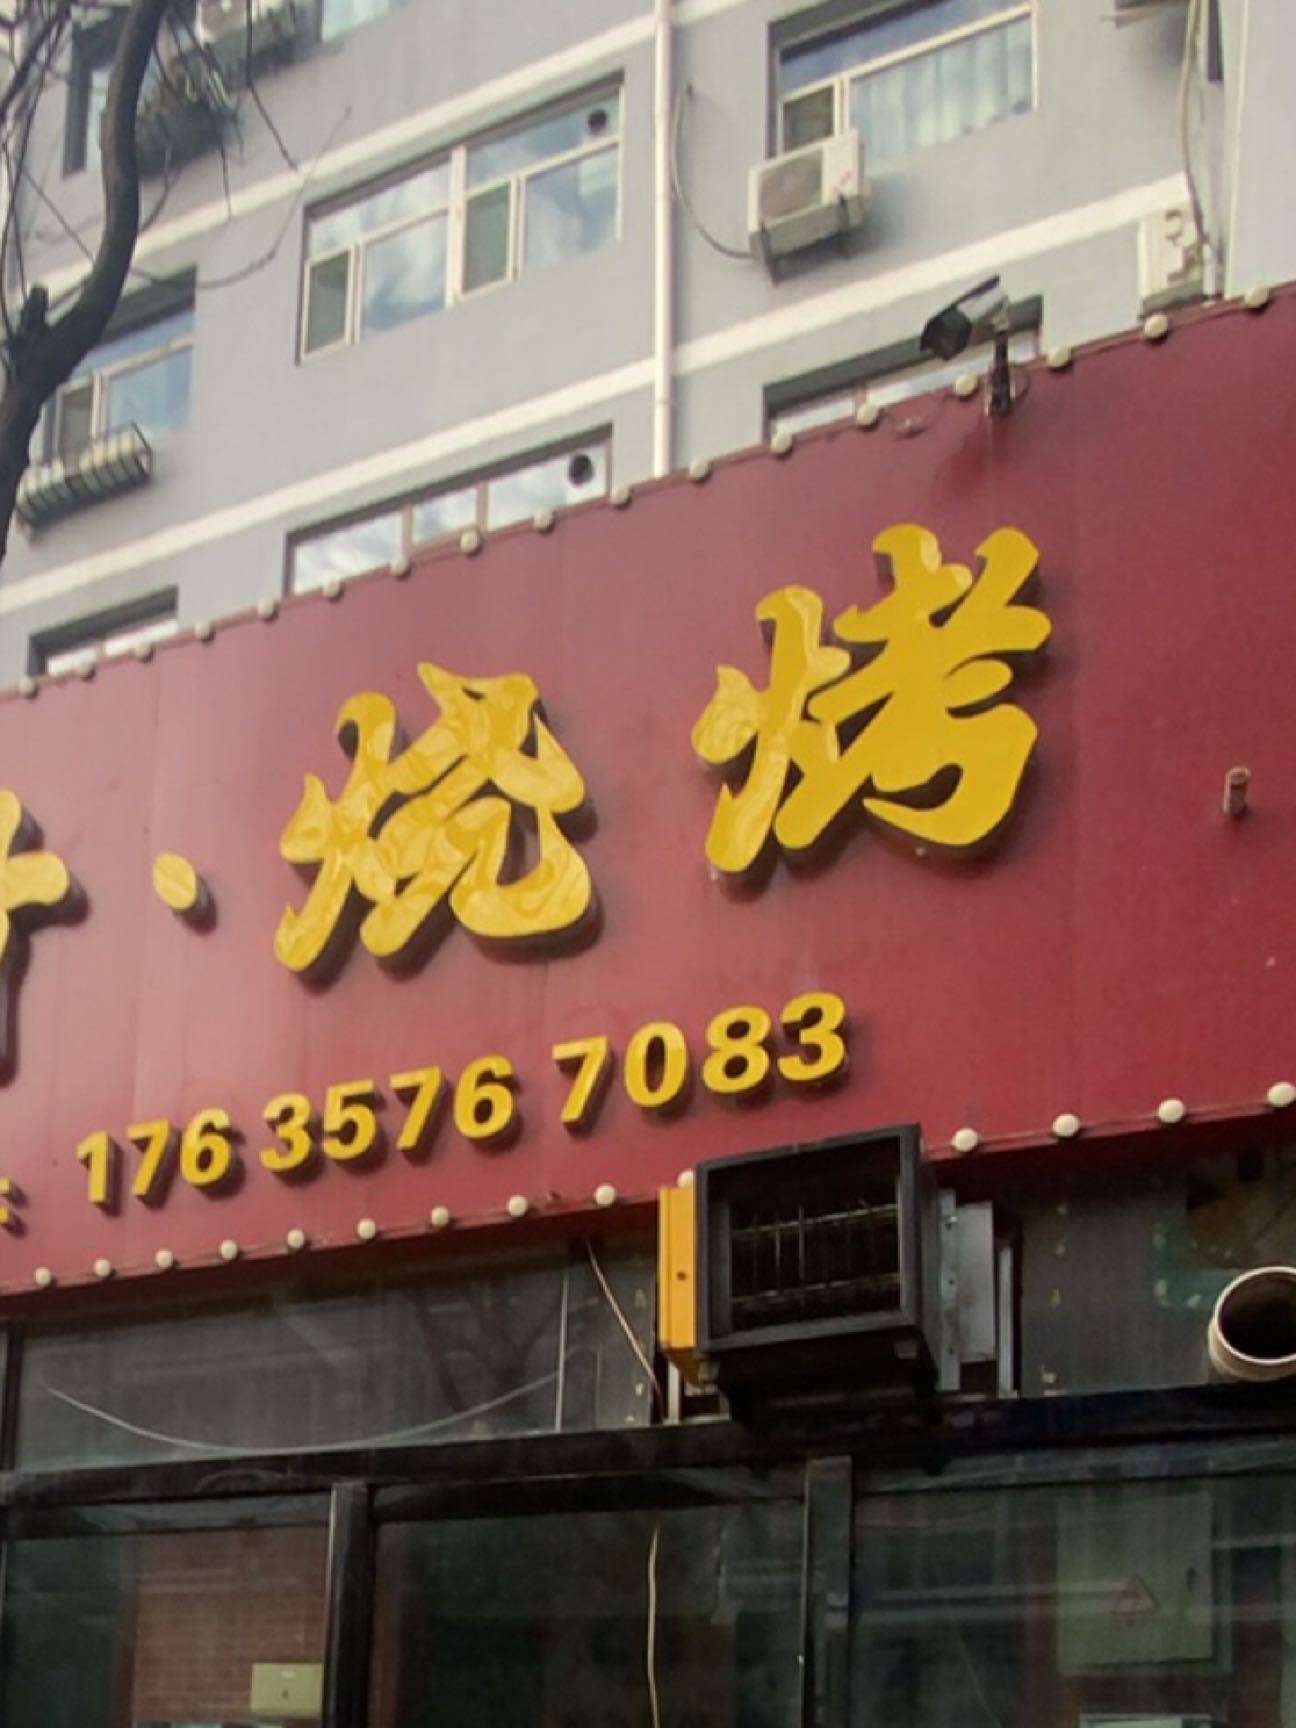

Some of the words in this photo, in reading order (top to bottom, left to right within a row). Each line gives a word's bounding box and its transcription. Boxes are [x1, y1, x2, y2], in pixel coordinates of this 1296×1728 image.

[77, 1108, 233, 1204] 176
[260, 1054, 515, 1171] 3576
[552, 991, 847, 1123] 7083
